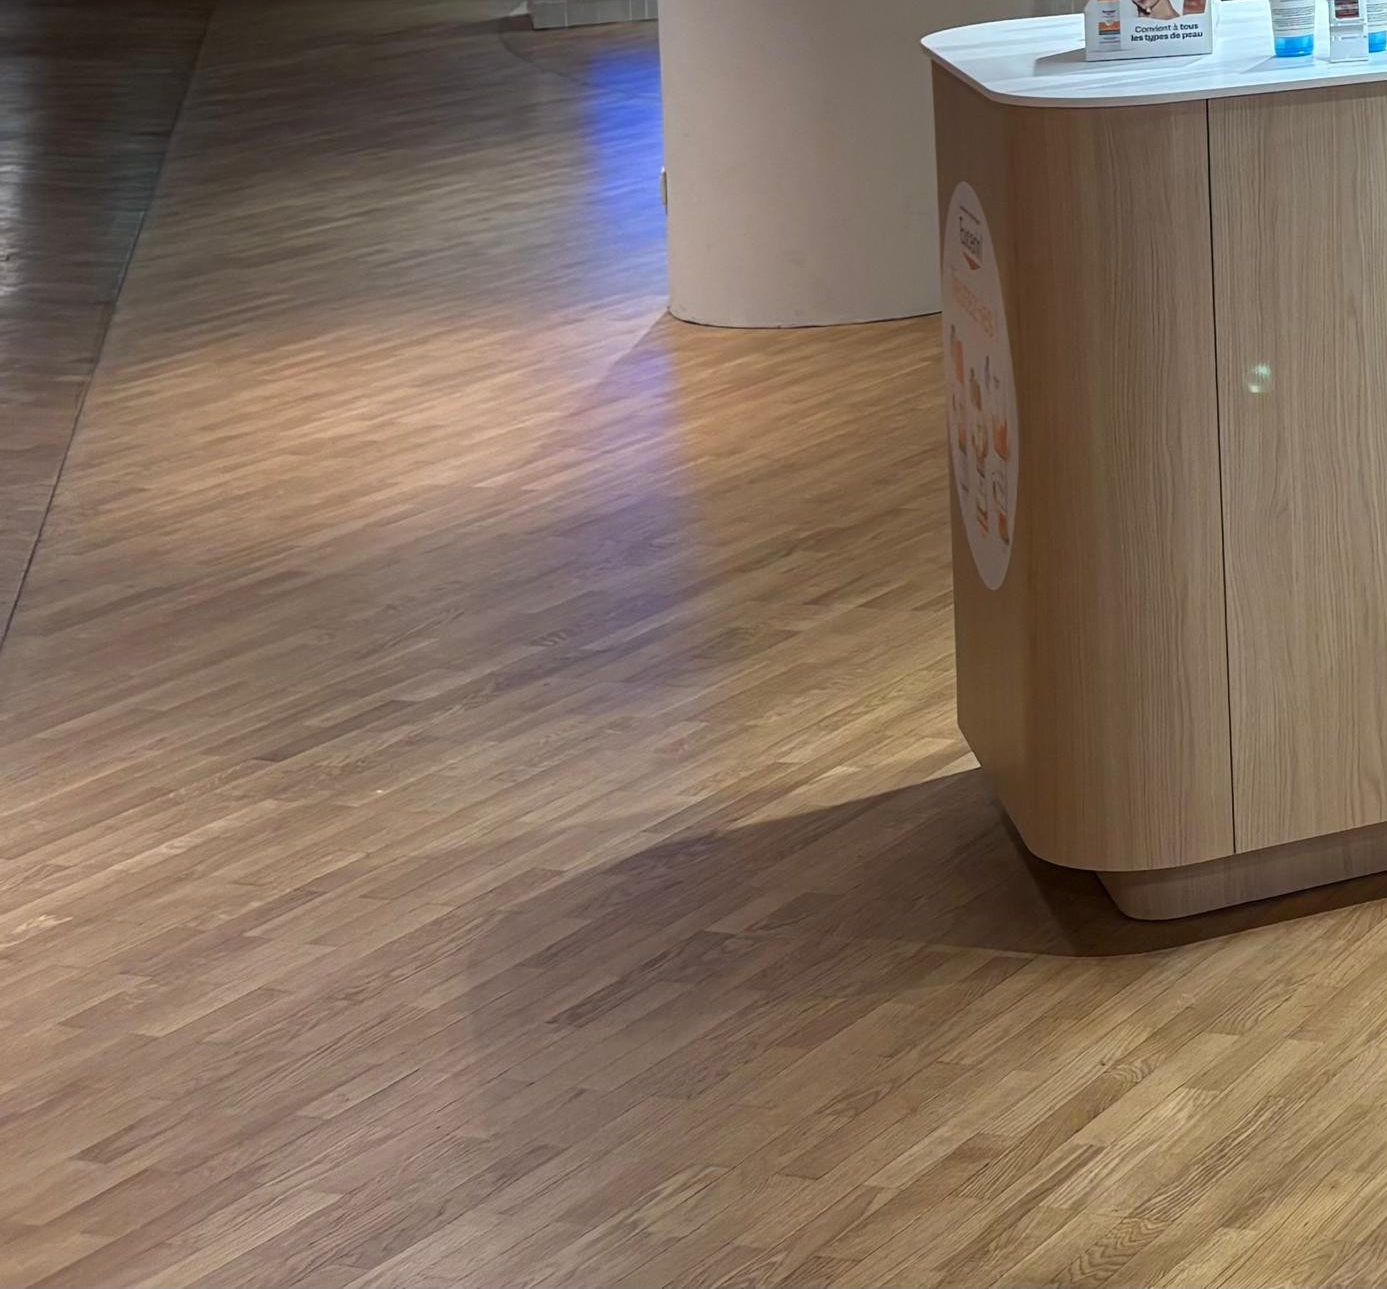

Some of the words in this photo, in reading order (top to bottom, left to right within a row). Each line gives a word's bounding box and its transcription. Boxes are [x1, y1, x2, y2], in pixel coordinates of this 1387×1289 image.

[1134, 23, 1171, 33] Convient
[1172, 22, 1179, 31] à
[1180, 22, 1199, 31] tous
[1130, 33, 1144, 42] les
[1144, 32, 1169, 42] types
[1170, 30, 1181, 40] de
[1182, 30, 1203, 40] peau
